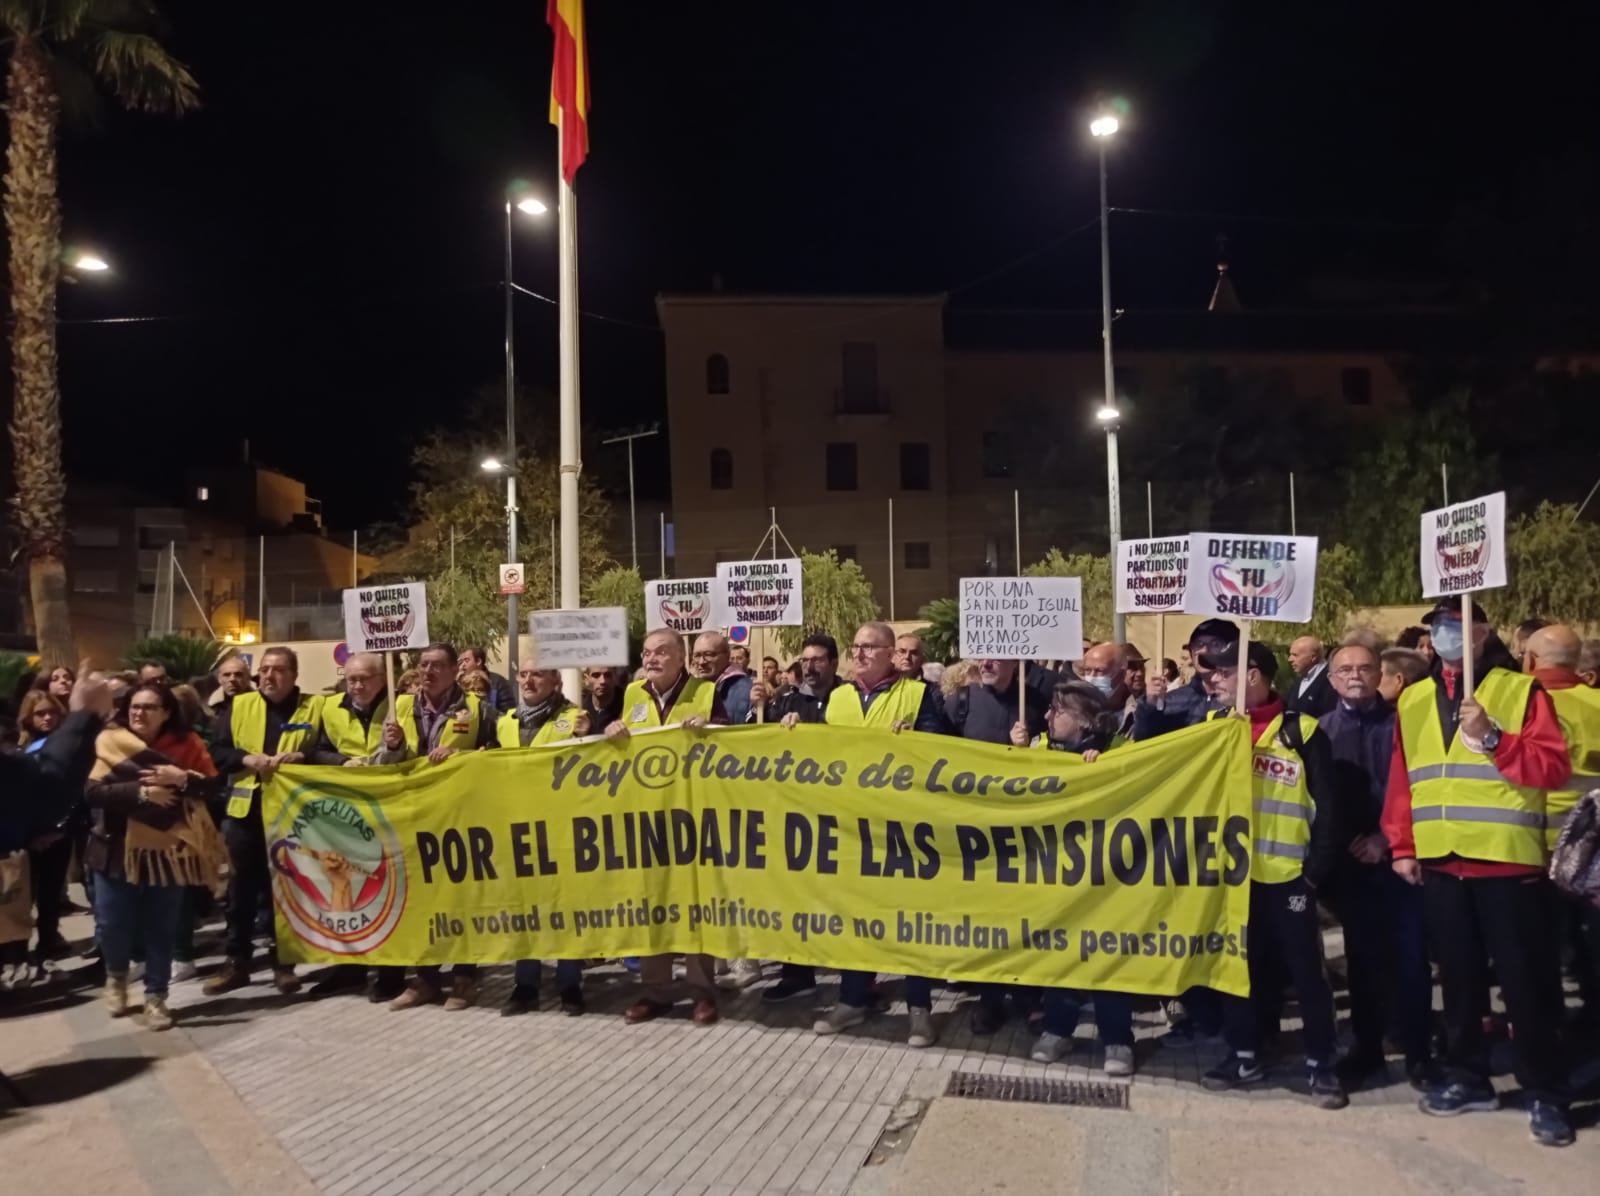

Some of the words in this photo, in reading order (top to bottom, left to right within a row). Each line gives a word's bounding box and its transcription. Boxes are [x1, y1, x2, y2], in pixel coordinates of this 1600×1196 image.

[1436, 512, 1449, 528] NO
[1452, 502, 1486, 526] QUIERO
[1436, 525, 1486, 550] MILAGROS
[1151, 541, 1181, 554] VOTAD
[1183, 540, 1189, 553] A
[1208, 539, 1296, 561] DEFIENDE
[1128, 558, 1174, 573] PARTIDOS
[1176, 557, 1189, 571] QU
[1444, 549, 1480, 572] QUIERO
[750, 564, 779, 576] VOTAD
[781, 563, 788, 574] A
[728, 579, 773, 592] PARTIDOS
[776, 579, 794, 591] QUE
[1127, 576, 1177, 590] RECORTAN
[1240, 568, 1265, 588] TU
[360, 591, 372, 603] NO
[375, 587, 409, 602] QUIERO
[657, 581, 709, 596] DEFIENDE
[964, 581, 997, 598] POR
[1003, 581, 1034, 598] UNA
[678, 600, 693, 613] TU
[728, 595, 776, 607] RECORTAN
[778, 594, 789, 605] EN
[963, 598, 1029, 611] SANIDAD
[1038, 598, 1079, 612] IGUAL
[1216, 594, 1279, 616] SALUD
[361, 603, 410, 619] MILAGROS
[369, 620, 403, 635] QUIERO
[666, 617, 702, 631] SALUD
[966, 614, 1004, 628] PARA
[1012, 614, 1058, 628] TODOS
[967, 629, 1030, 644] MISMOS
[968, 644, 1039, 655] SERVICIOS
[551, 744, 847, 797] Yay@flautas
[858, 752, 915, 791] de
[925, 758, 1067, 795] Lorca
[288, 799, 376, 842] YAYOFLAUTAS
[416, 826, 498, 884] POR
[510, 820, 558, 878] EL
[572, 808, 766, 873] BLINDAJE
[785, 812, 839, 875] DE
[858, 817, 941, 880] LAS
[956, 815, 1250, 887] PENSIONES
[318, 911, 371, 933] LORCA
[429, 912, 464, 945] ¡No
[472, 904, 541, 934] votad
[550, 911, 565, 930] a
[573, 898, 680, 936] partidos
[688, 897, 782, 931] políticos
[792, 912, 843, 942] que
[852, 917, 886, 940] no
[897, 911, 1009, 950] blindan
[1022, 918, 1068, 951] las
[1079, 922, 1247, 962] pensiones!
